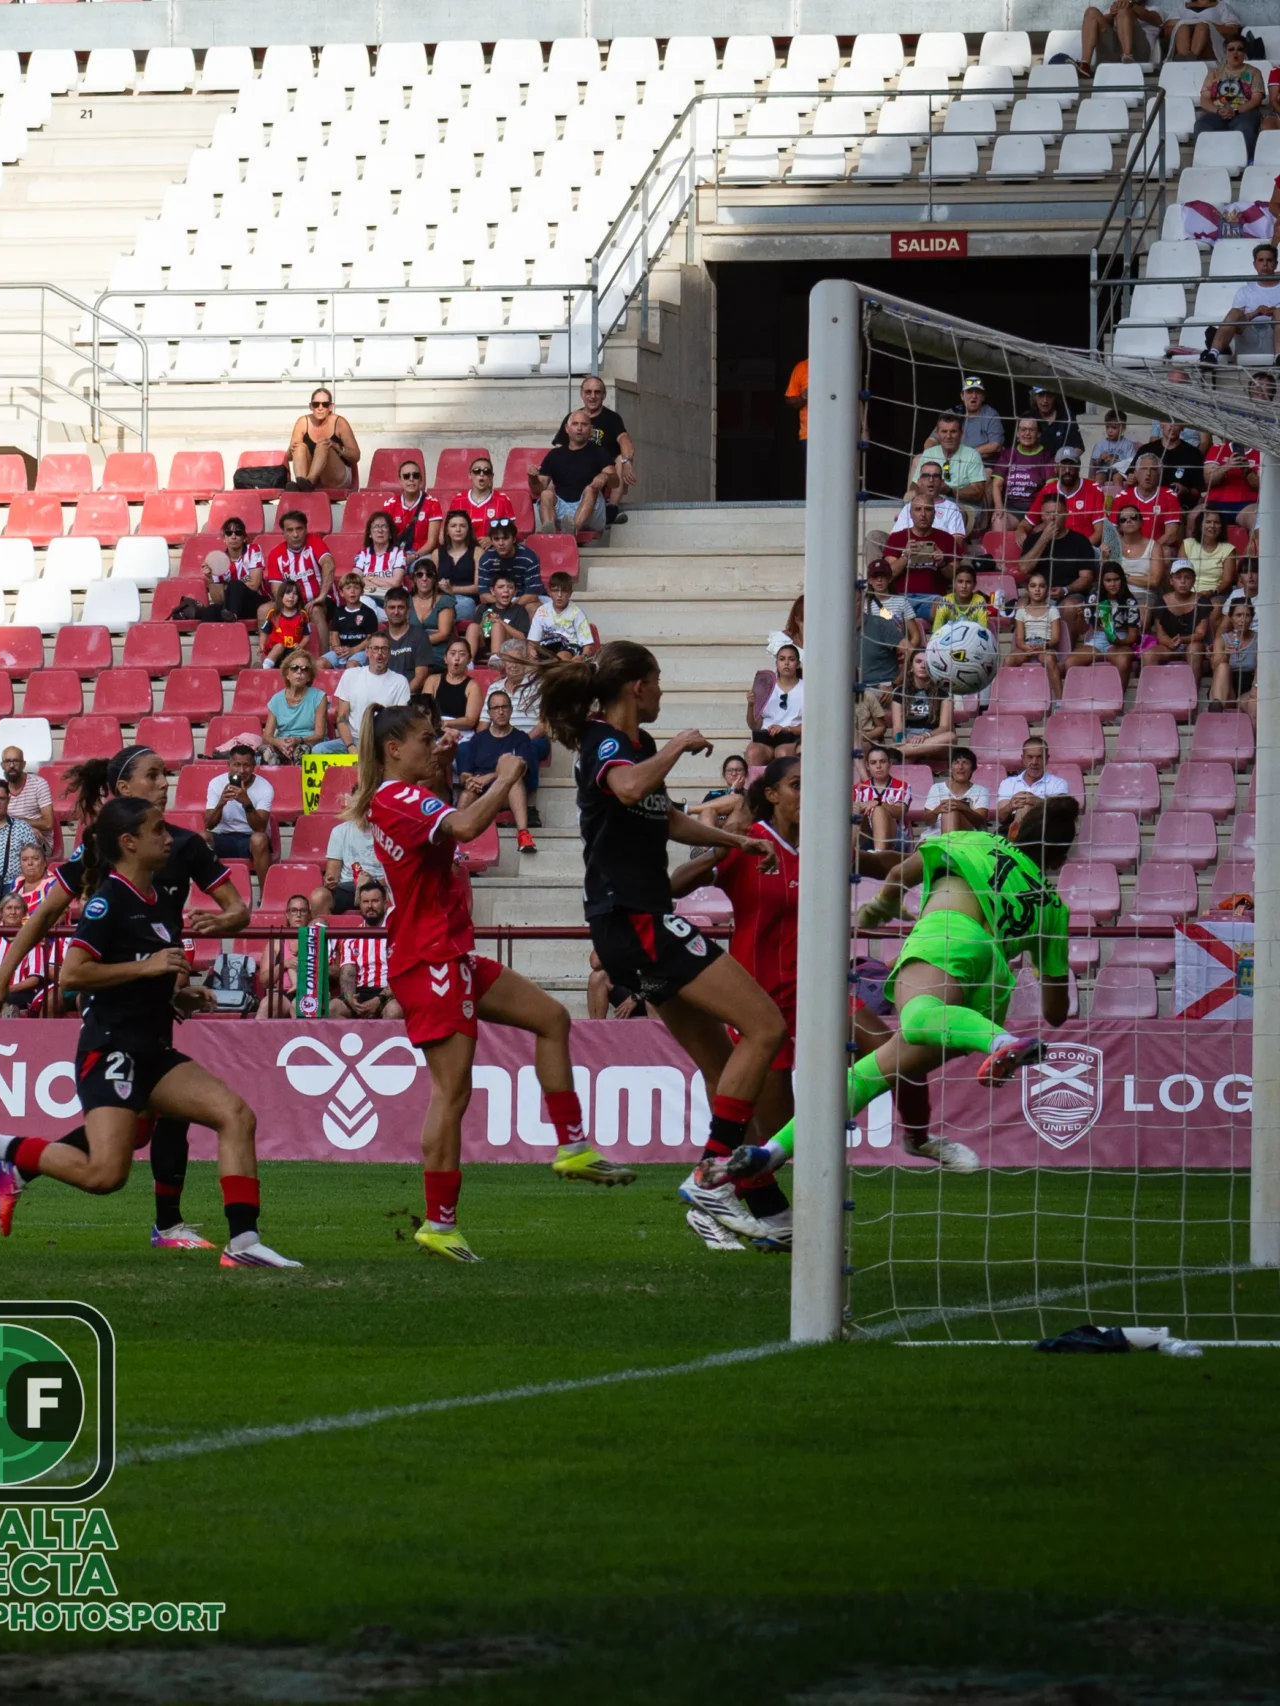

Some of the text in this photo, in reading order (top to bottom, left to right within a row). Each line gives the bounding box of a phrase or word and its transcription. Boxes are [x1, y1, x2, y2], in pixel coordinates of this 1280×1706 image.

[79, 109, 93, 119] 21
[898, 237, 960, 252] SALIDA
[663, 913, 692, 938] 6
[460, 962, 472, 995] 9
[1043, 1051, 1095, 1064] GROÑO
[1042, 1122, 1082, 1132] UNITED
